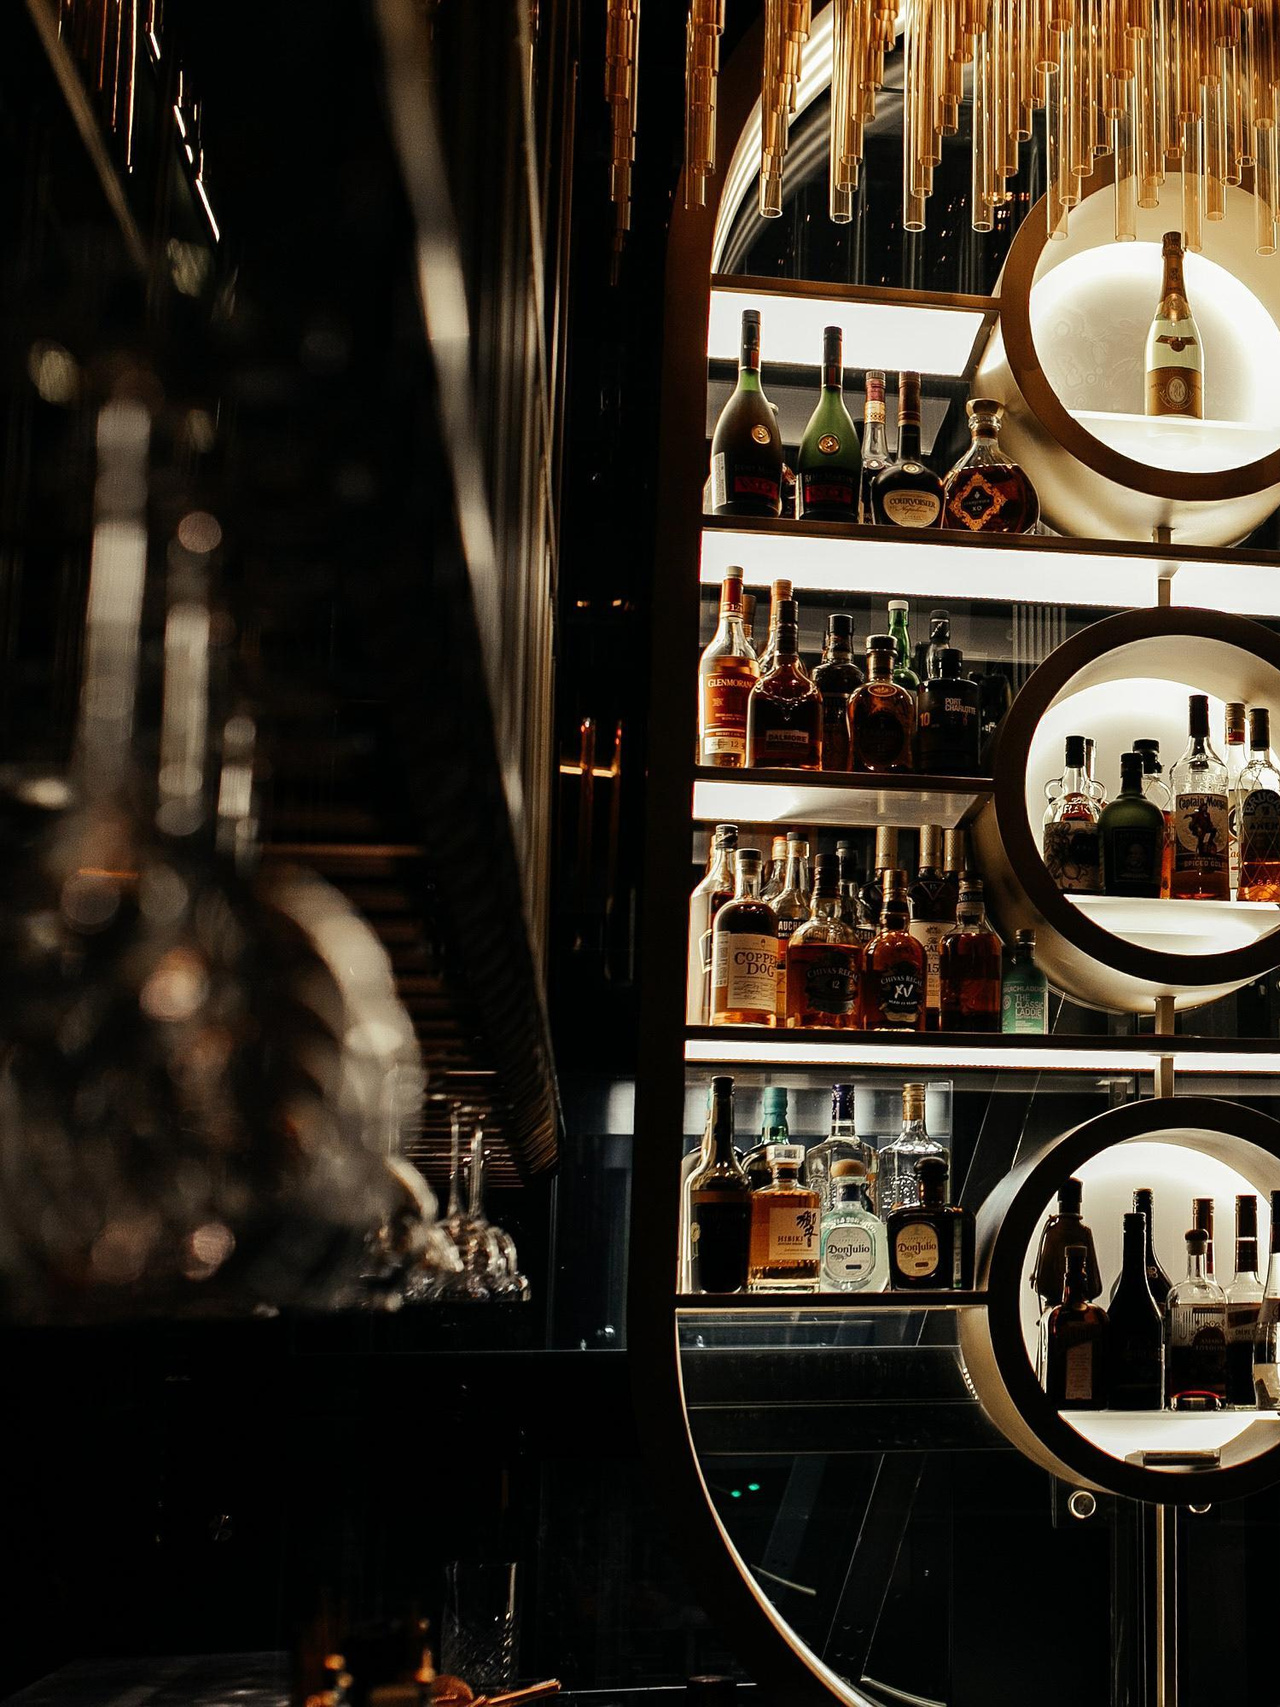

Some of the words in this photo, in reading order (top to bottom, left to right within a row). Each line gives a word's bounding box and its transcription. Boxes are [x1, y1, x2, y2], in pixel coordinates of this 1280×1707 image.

[707, 679, 755, 689] GLENMORAN
[945, 697, 962, 705] PORT
[945, 704, 977, 714] CHARLOTTE
[919, 712, 931, 727] 10
[730, 740, 739, 748] 12
[1179, 795, 1204, 810] Captain
[746, 962, 774, 977] DOG
[928, 963, 940, 973] 15
[806, 967, 837, 979] CHIVAS
[837, 966, 859, 982] REGAL
[832, 980, 841, 989] 12
[880, 975, 905, 985] CHIVAS
[905, 975, 923, 987] REGAL
[894, 984, 914, 999] XV
[1015, 993, 1030, 1001] THE
[1015, 1001, 1044, 1009] CLASSIC
[1015, 1008, 1042, 1016] LADDIE
